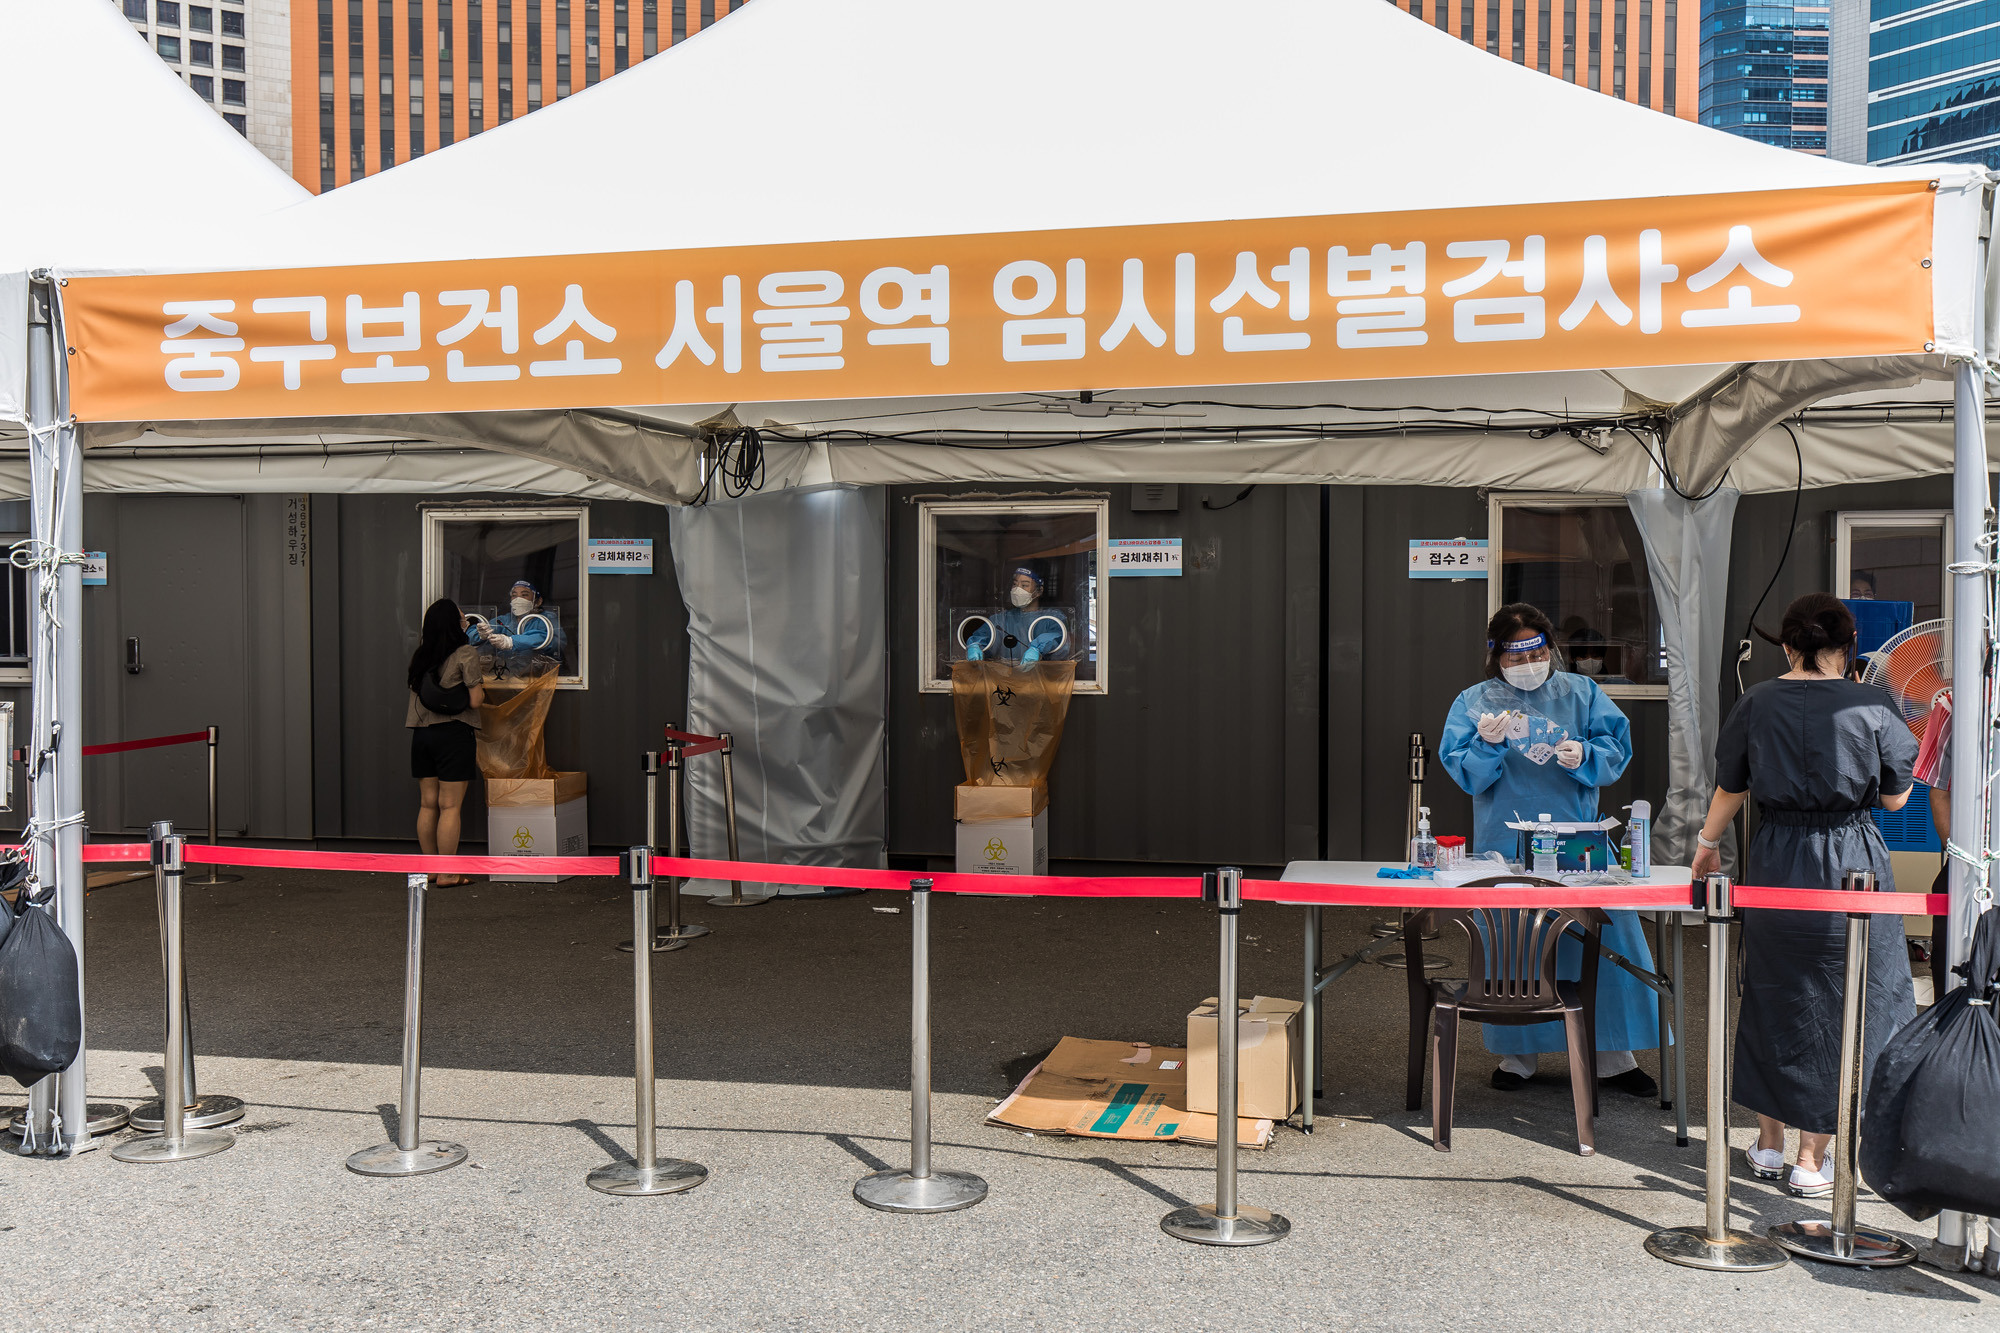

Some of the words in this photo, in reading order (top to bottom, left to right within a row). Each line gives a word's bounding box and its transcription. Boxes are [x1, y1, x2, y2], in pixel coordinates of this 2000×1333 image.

[160, 284, 622, 392] 중구보건소
[655, 264, 950, 374] 서울역
[993, 224, 1800, 362] 임시선별검사소
[287, 497, 298, 566] 거성하우징
[598, 551, 642, 561] 검체채취2
[1120, 552, 1169, 562] 검체채취1
[1429, 552, 1456, 565] 접수
[1459, 553, 1469, 565] 2
